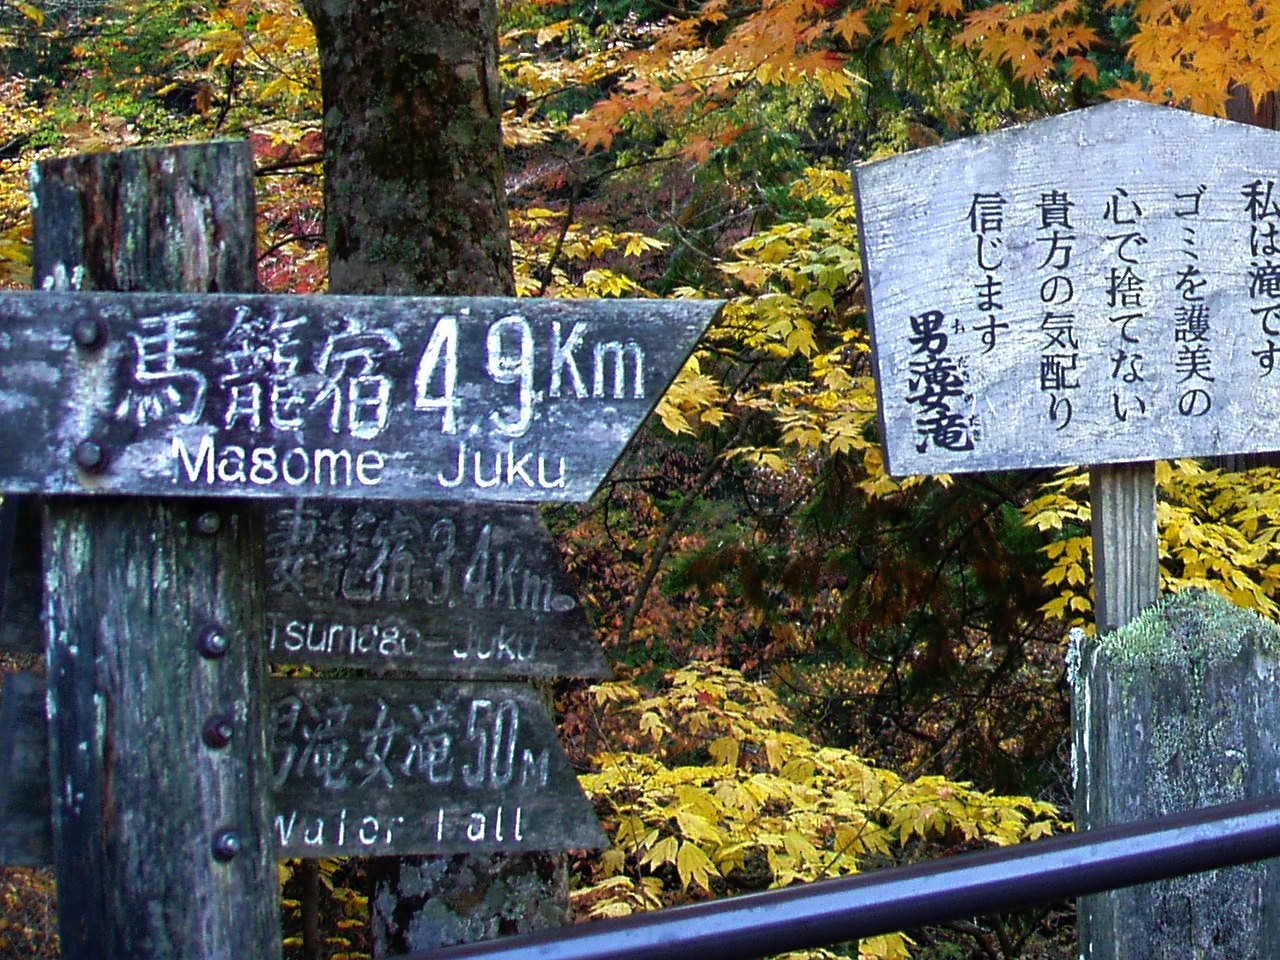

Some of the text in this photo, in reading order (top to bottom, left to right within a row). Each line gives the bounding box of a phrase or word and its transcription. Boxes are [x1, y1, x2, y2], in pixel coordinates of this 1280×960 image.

[966, 191, 1010, 356] 信じます
[1035, 189, 1081, 432] 貴方の気配り
[1102, 186, 1147, 423] 心で捨てない
[1171, 183, 1216, 419] ゴミを護美の
[436, 442, 567, 490] Juku
[905, 309, 975, 454] 男滝女滝
